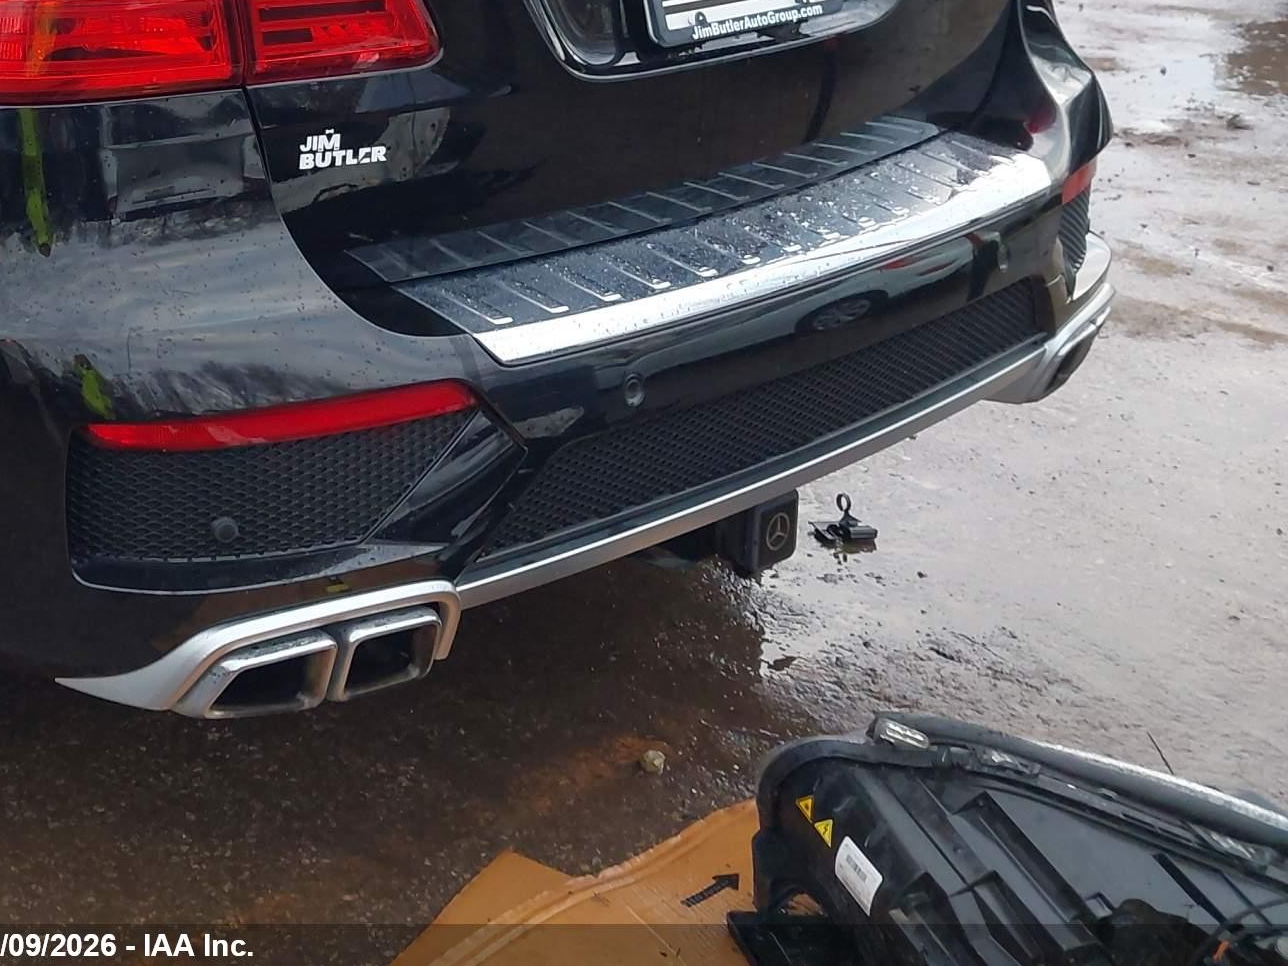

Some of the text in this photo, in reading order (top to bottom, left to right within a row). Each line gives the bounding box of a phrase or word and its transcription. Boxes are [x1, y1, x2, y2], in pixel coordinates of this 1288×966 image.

[692, 4, 824, 41] JimButlerAutoGroup.com
[299, 133, 341, 152] JIM
[298, 145, 387, 170] BUTLER
